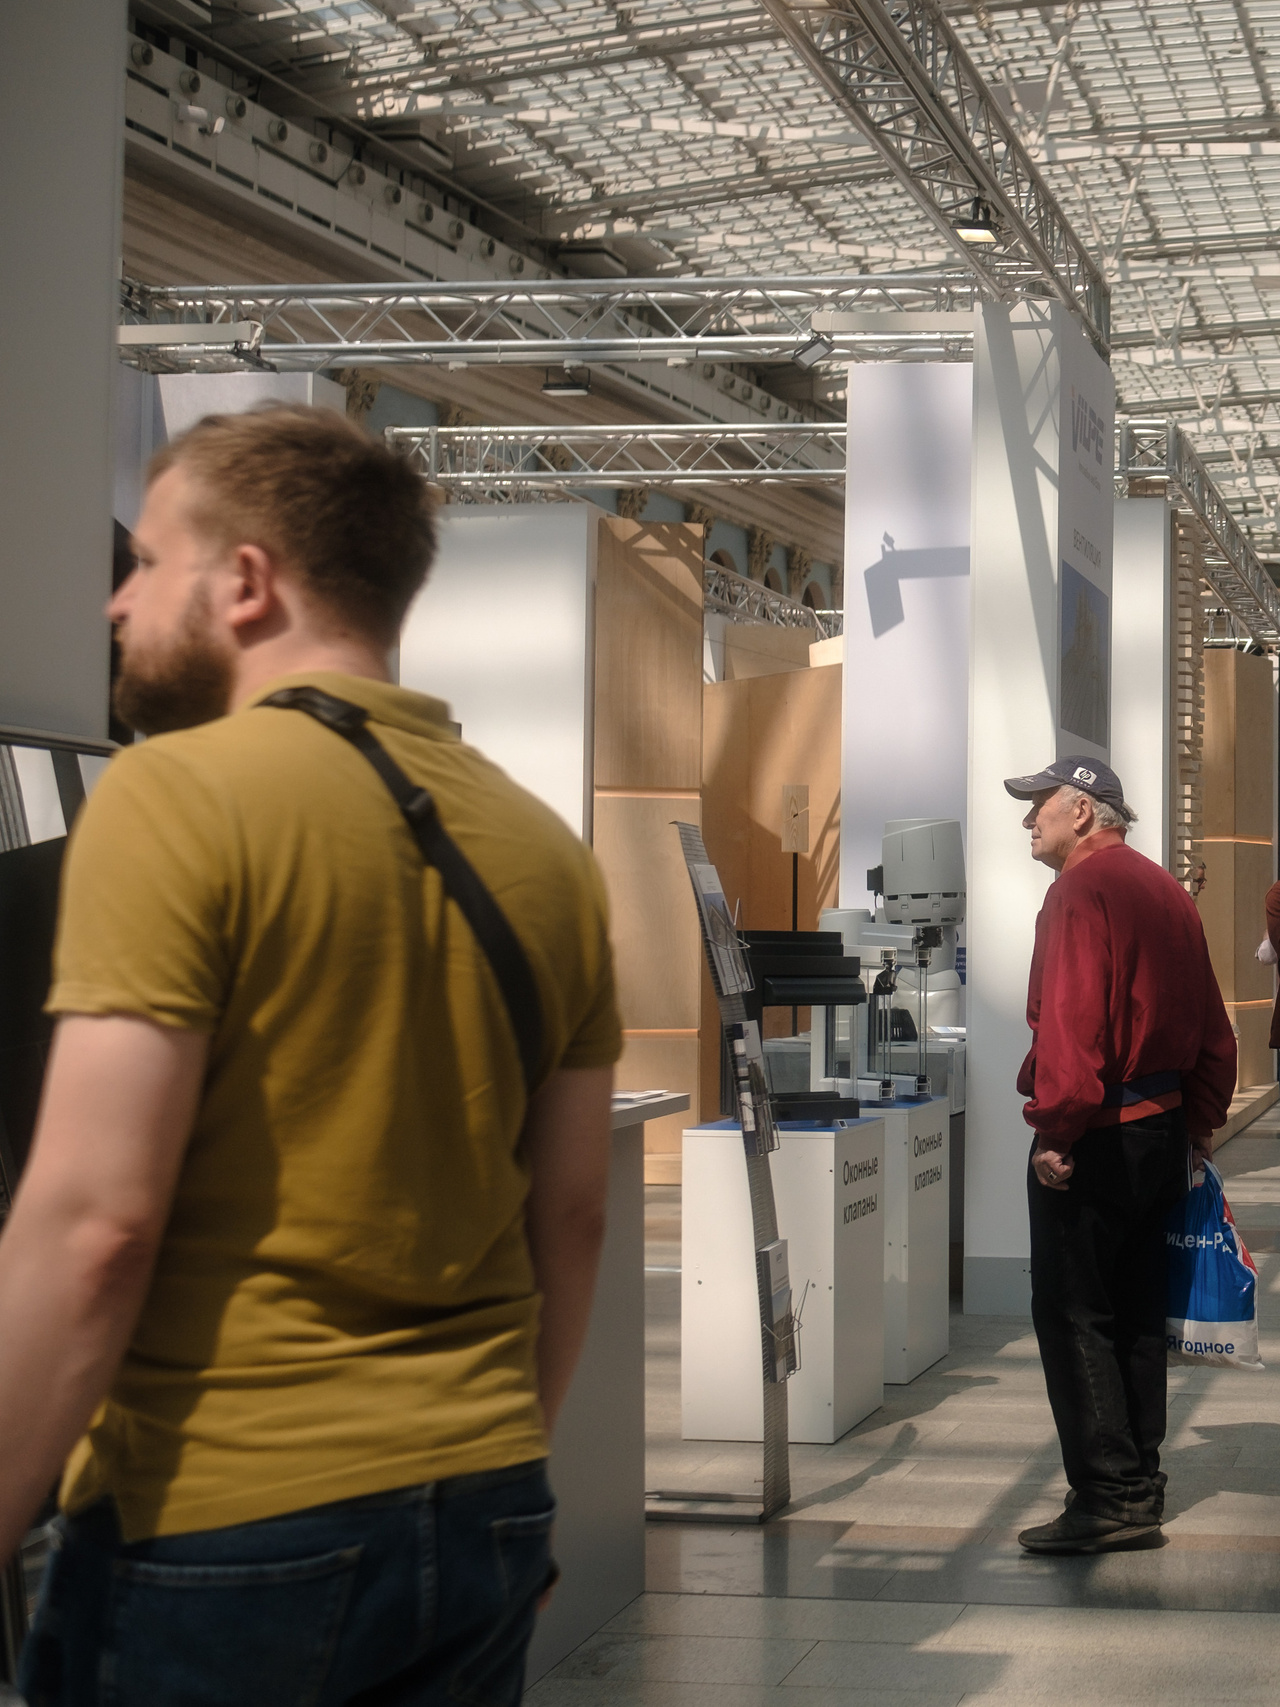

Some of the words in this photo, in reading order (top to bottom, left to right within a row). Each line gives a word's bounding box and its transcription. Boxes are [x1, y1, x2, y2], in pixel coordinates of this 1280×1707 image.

[914, 1132, 943, 1158] Оконные
[843, 1157, 878, 1186] Оконные
[914, 1164, 943, 1192] клапаны
[843, 1193, 878, 1225] клапаны
[1166, 1335, 1235, 1355] Ягодное
